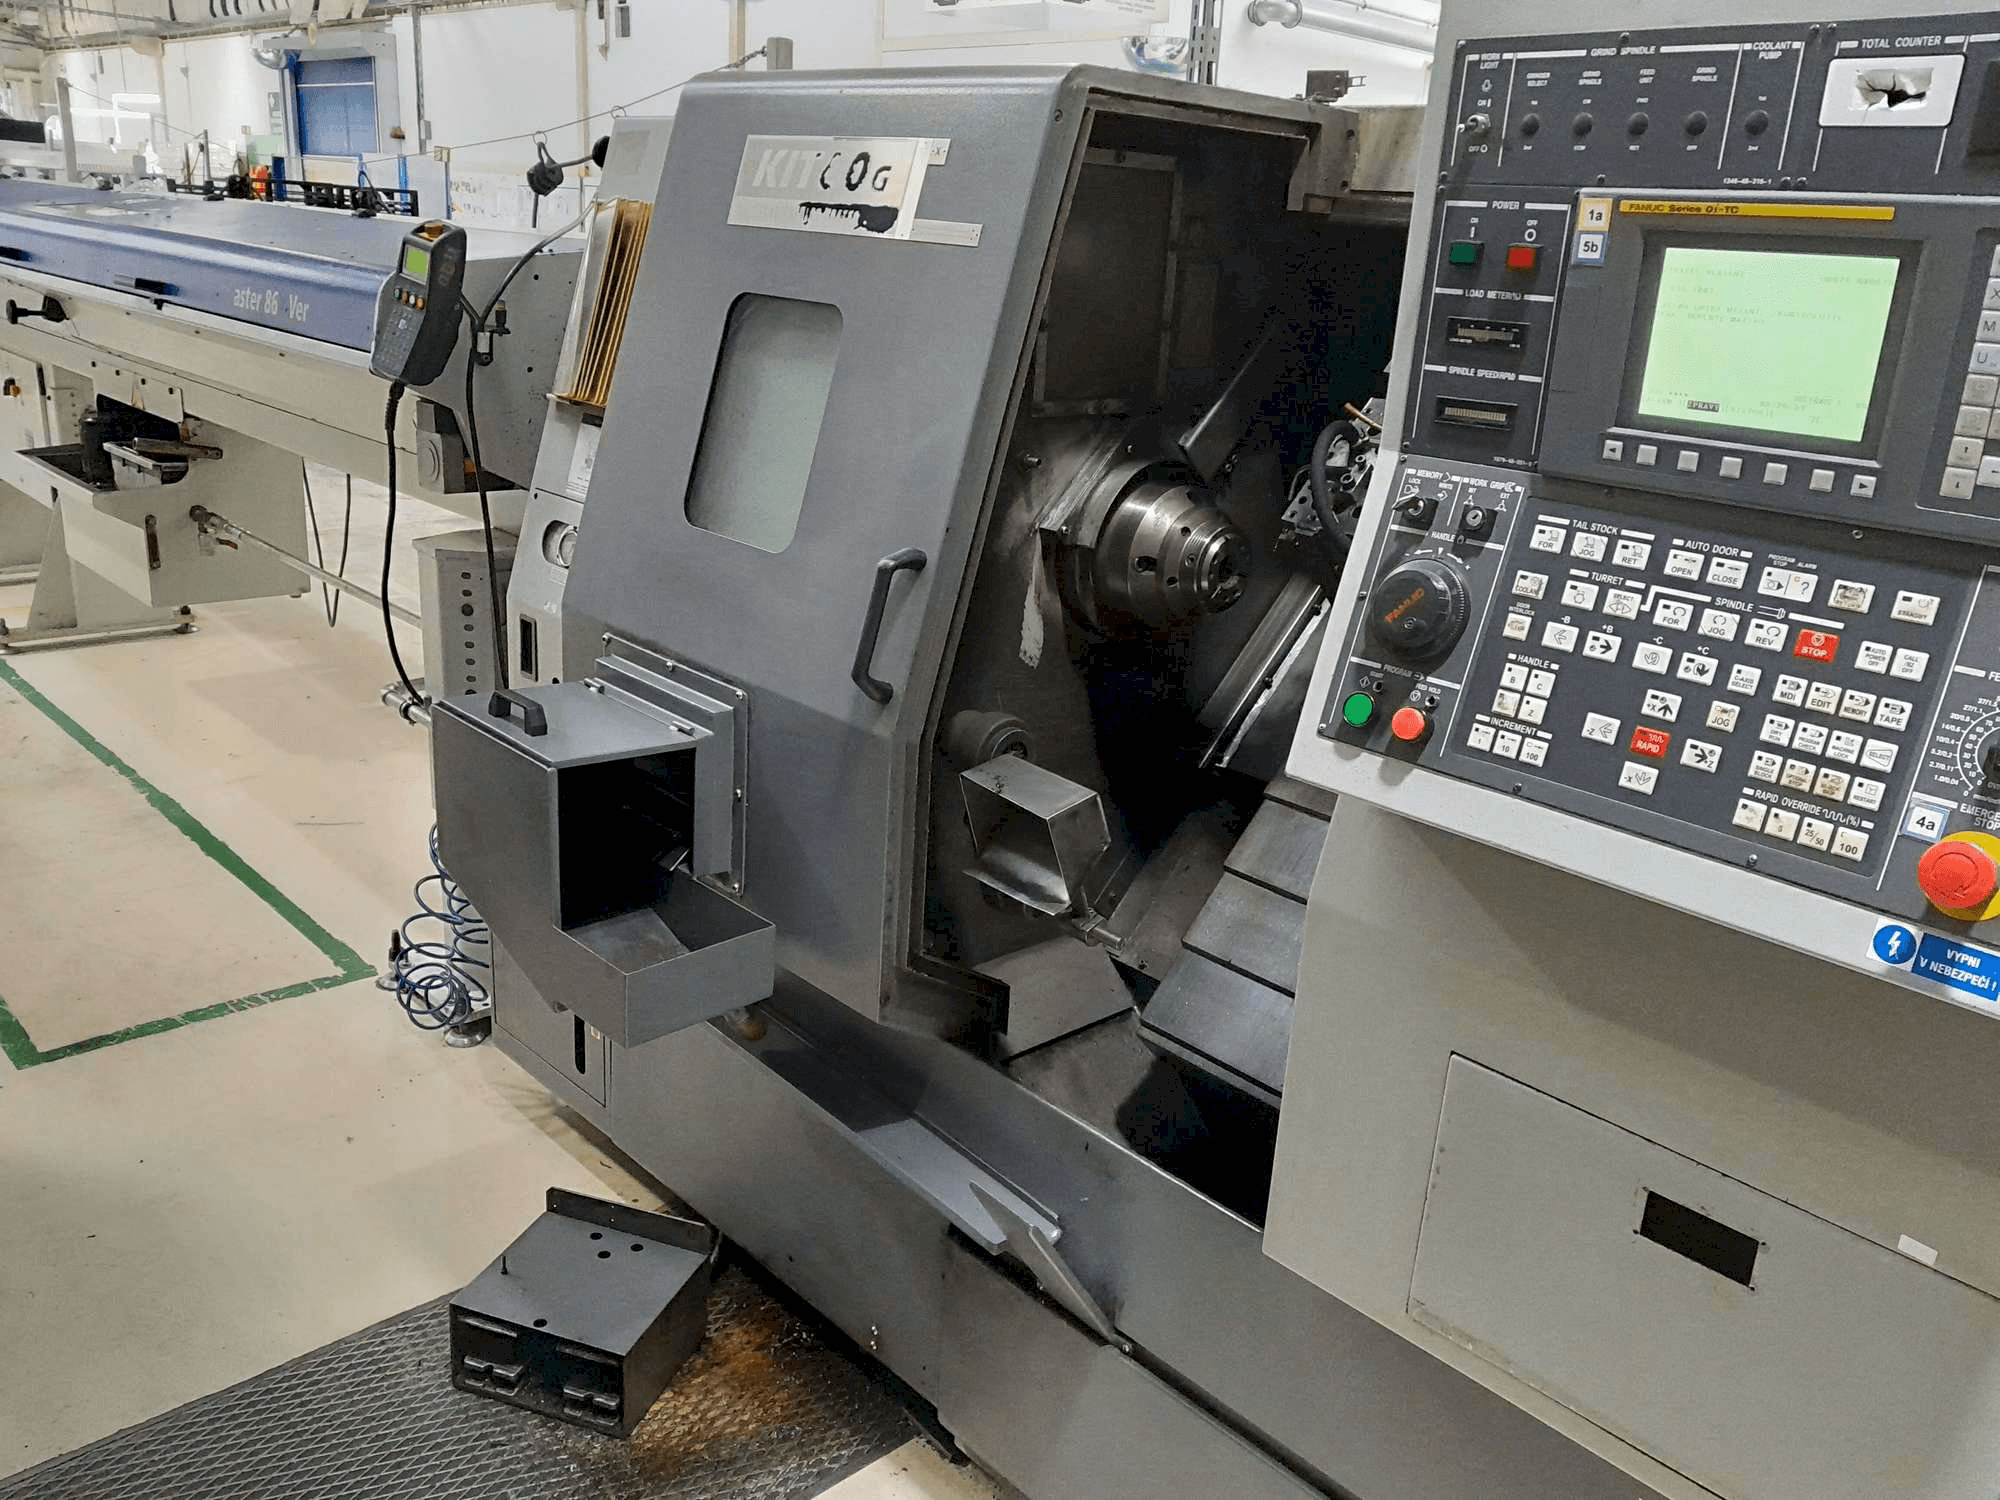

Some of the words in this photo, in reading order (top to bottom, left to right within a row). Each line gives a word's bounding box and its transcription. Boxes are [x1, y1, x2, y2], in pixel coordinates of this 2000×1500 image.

[1753, 40, 1792, 50] COOLANT
[1861, 38, 1891, 49] TOTAL
[1895, 35, 1942, 47] COUNTER
[1590, 47, 1617, 56] GRIND
[1620, 45, 1656, 56] SPINDLE
[1758, 50, 1782, 60] PUMP
[1480, 61, 1500, 70] LIGHT
[1492, 201, 1520, 210] POWER
[1629, 203, 1665, 212] FANUC
[1668, 204, 1702, 213] Series
[1588, 209, 1603, 222] 1a
[1583, 240, 1599, 254] 5b
[1465, 289, 1485, 298] LOAD
[233, 287, 262, 312] aster
[263, 289, 279, 316] 86
[288, 294, 310, 322] Ver
[1983, 320, 1997, 333] M
[1976, 351, 1989, 364] U
[1447, 366, 1475, 377] SPINDLE
[1416, 469, 1443, 480] MEMORY
[1408, 477, 1421, 485] LOCK
[1469, 478, 1488, 488] WORK
[1572, 519, 1589, 531] TAIL
[1590, 522, 1619, 535] STOCK
[1431, 531, 1457, 543] HANDLE
[1537, 540, 1554, 549] FOR
[1685, 540, 1710, 552] AUTO
[1711, 543, 1739, 557] DOOR
[1578, 549, 1596, 558] JOG
[1621, 556, 1638, 566] RET
[1773, 560, 1788, 568] STOP
[1797, 561, 1818, 570] ALARM
[1671, 566, 1693, 576] OPEN
[1591, 572, 1625, 586] TURRET
[1712, 574, 1739, 586] CLOSE
[1715, 597, 1755, 613] SPINDLE
[1508, 606, 1536, 617] INTERLOCK
[1561, 615, 1572, 624] -B
[1662, 616, 1681, 626] FOR
[1602, 624, 1614, 634] +B
[1707, 626, 1726, 637] JOG
[1652, 636, 1664, 645] -C
[1755, 636, 1775, 647] REV
[1697, 646, 1710, 656] +C
[1801, 646, 1828, 658] STOP
[1517, 655, 1550, 669] HANDLE
[1865, 653, 1886, 663] POWER
[1510, 676, 1516, 685] B
[1537, 682, 1544, 691] C
[1779, 690, 1796, 702] MDI
[1810, 698, 1833, 709] EDIT
[1527, 708, 1535, 717] Z
[1844, 706, 1868, 717] MEMORY
[1490, 716, 1538, 735] INCREMENT
[1711, 715, 1731, 728] JOG
[1879, 714, 1903, 726] TAPE
[1501, 744, 1511, 753] 10
[1636, 740, 1661, 753] RAPID
[1525, 752, 1539, 762] 100
[1754, 789, 1779, 803] RAPID
[1781, 796, 1822, 816] OVERRIDE
[1846, 814, 1861, 827] (%)
[1915, 815, 1936, 832] 4a
[1974, 816, 2000, 831] STOP
[1804, 829, 1825, 847] 25/50
[1839, 842, 1859, 855] 100
[1947, 948, 1981, 969] VYPNI
[1930, 960, 1990, 989] NEBEZPEČÍ
[1991, 980, 1998, 992] !
